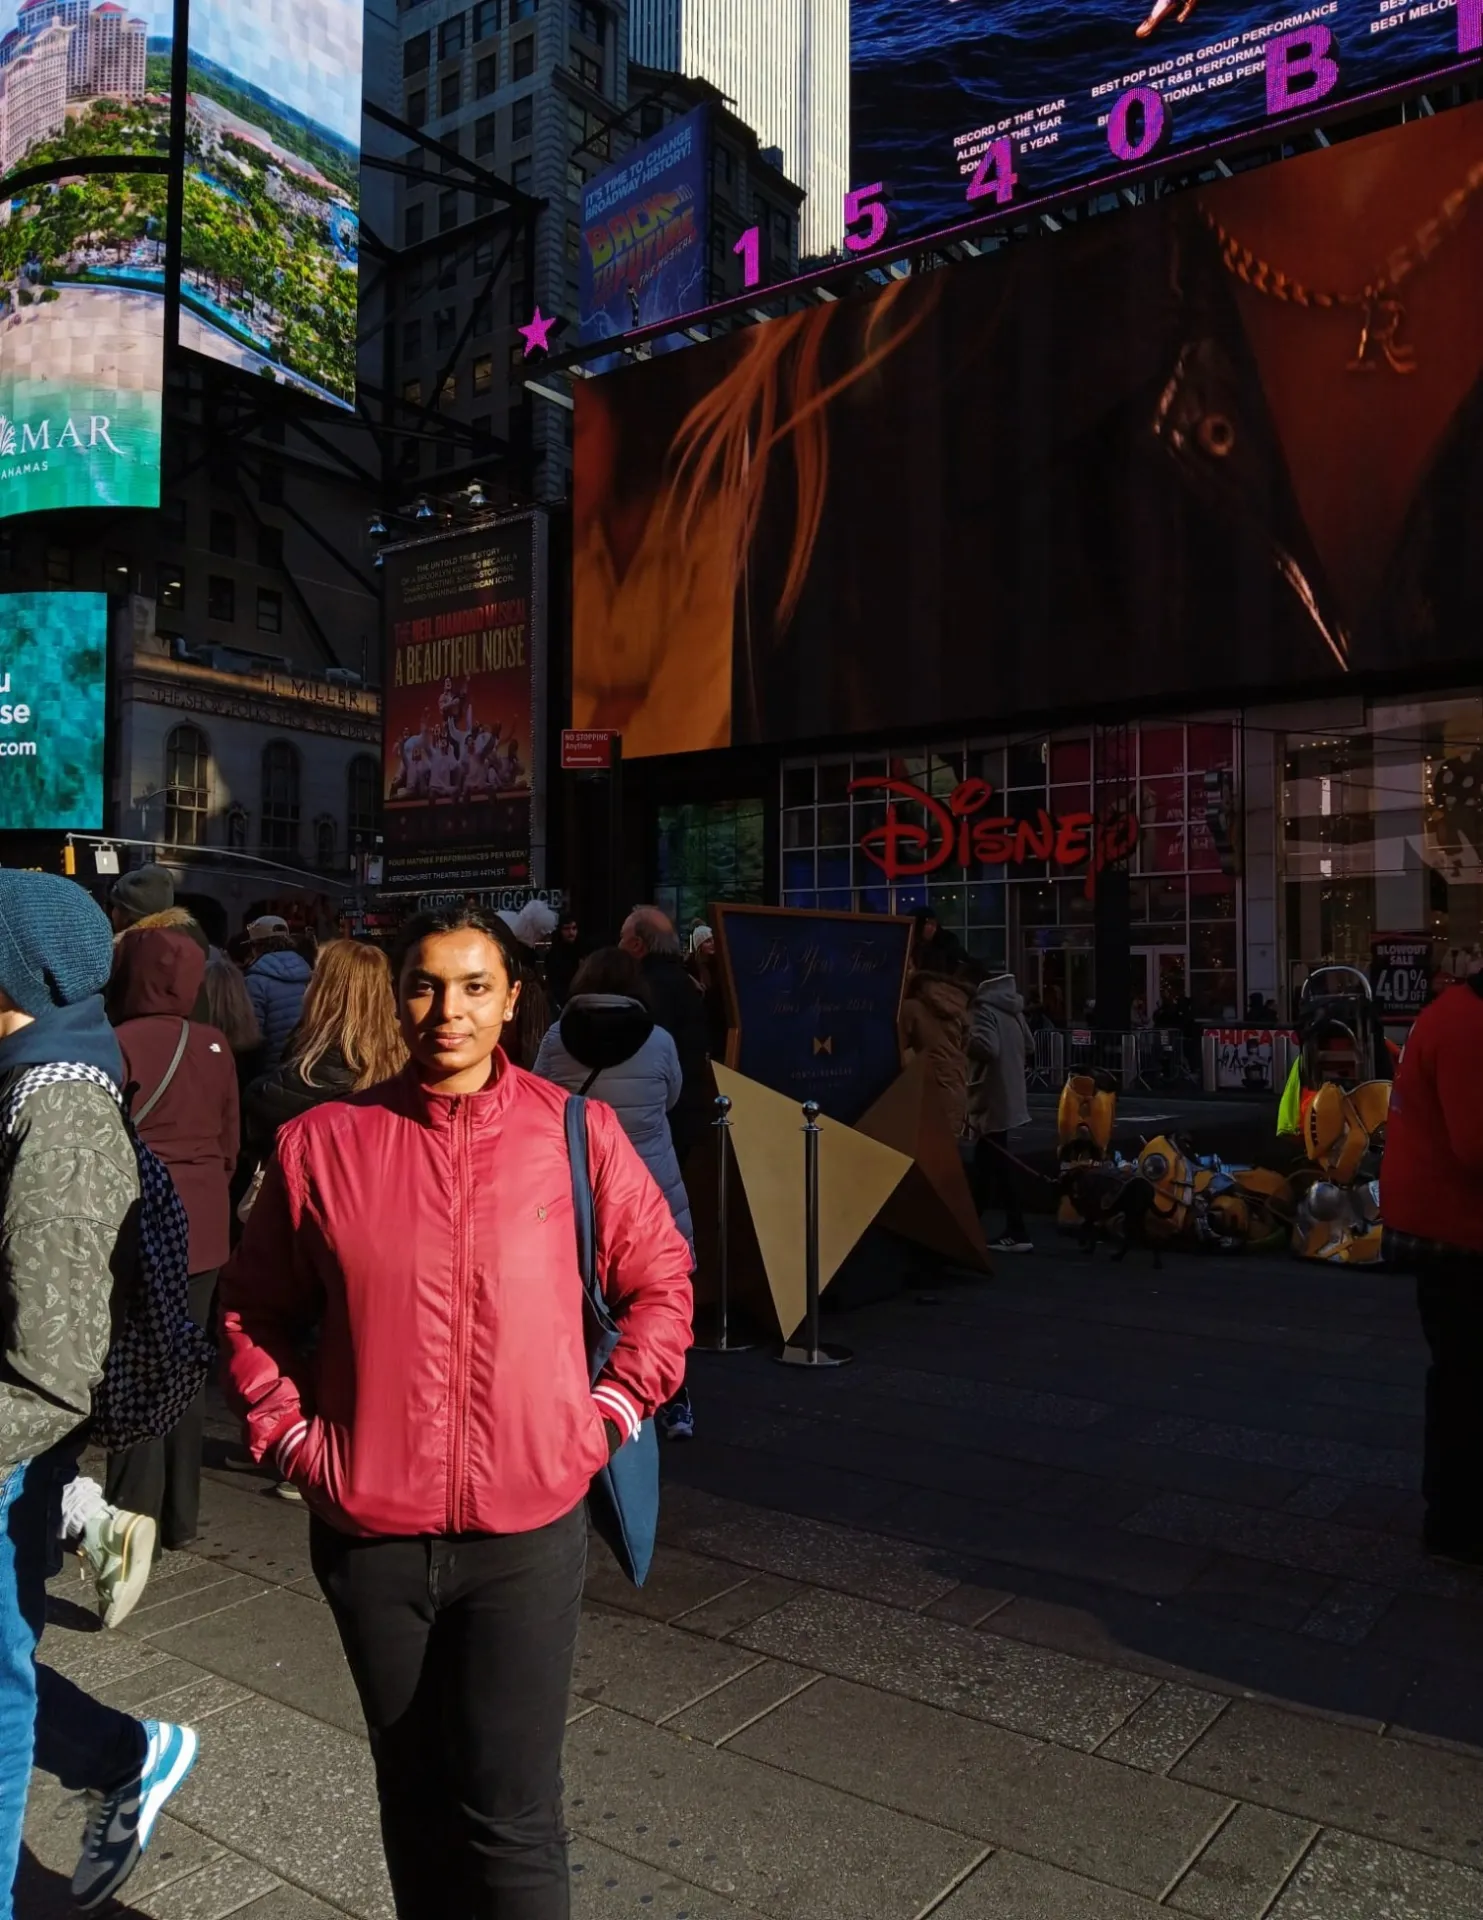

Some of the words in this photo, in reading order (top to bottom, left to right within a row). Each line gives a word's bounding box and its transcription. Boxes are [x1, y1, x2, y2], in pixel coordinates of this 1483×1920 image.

[1370, 12, 1406, 34] BEST
[1409, 0, 1457, 20] MELOD
[1092, 79, 1120, 97] BEST
[1123, 70, 1146, 86] POP
[1149, 61, 1174, 77] DUO
[1176, 53, 1193, 67] OR
[1196, 36, 1239, 59] GROUP
[1242, 1, 1338, 44] PERFORMANCE
[1168, 70, 1193, 86] R&B
[1195, 44, 1266, 77] PERFORMA
[1163, 82, 1205, 103] TIONAL
[1208, 72, 1233, 88] R&B
[954, 124, 995, 147] RECORD
[997, 118, 1011, 131] OF
[1014, 109, 1034, 125] THE
[1037, 99, 1066, 117] YEAR
[1011, 126, 1030, 141] THE
[1033, 116, 1062, 133] YEAR
[586, 187, 603, 208] IT'S
[605, 168, 629, 196] TIME
[630, 160, 644, 178] TO
[646, 126, 692, 166] CHANGE
[960, 158, 981, 174] SON
[1030, 132, 1058, 149] YEAR
[585, 176, 641, 222] BROADWAY
[642, 141, 692, 183] HISTORY!
[585, 190, 681, 270] BACK
[20, 415, 127, 455] MAR
[416, 563, 429, 573] THE
[431, 557, 458, 570] UNTOLD
[459, 551, 477, 563] TRUE
[477, 547, 500, 560] STORY
[417, 568, 450, 583] BROOKLYN
[482, 555, 511, 569] BECAME
[458, 579, 495, 593] AMERICAN
[394, 621, 411, 645] THE
[411, 617, 432, 642] NEIL
[435, 606, 484, 638] DIAMOND
[485, 597, 526, 629] MUSICAL
[394, 647, 405, 688] A
[406, 633, 480, 686] BEAUTIFUL
[482, 624, 526, 673] NOISE
[291, 678, 360, 709] MILLER
[564, 732, 575, 741] NO
[576, 732, 609, 741] STOPPING
[565, 742, 593, 750] Anytime
[388, 858, 405, 867] FOUR
[406, 856, 434, 867] MATINEE
[435, 851, 489, 865] PERFORMANCES
[491, 851, 505, 860] PER
[433, 871, 460, 880] THEATRE
[1376, 944, 1428, 956] BLOWOUT
[1390, 955, 1415, 967] SALE
[1375, 968, 1428, 1002] 40%
[1410, 990, 1427, 1002] OFF
